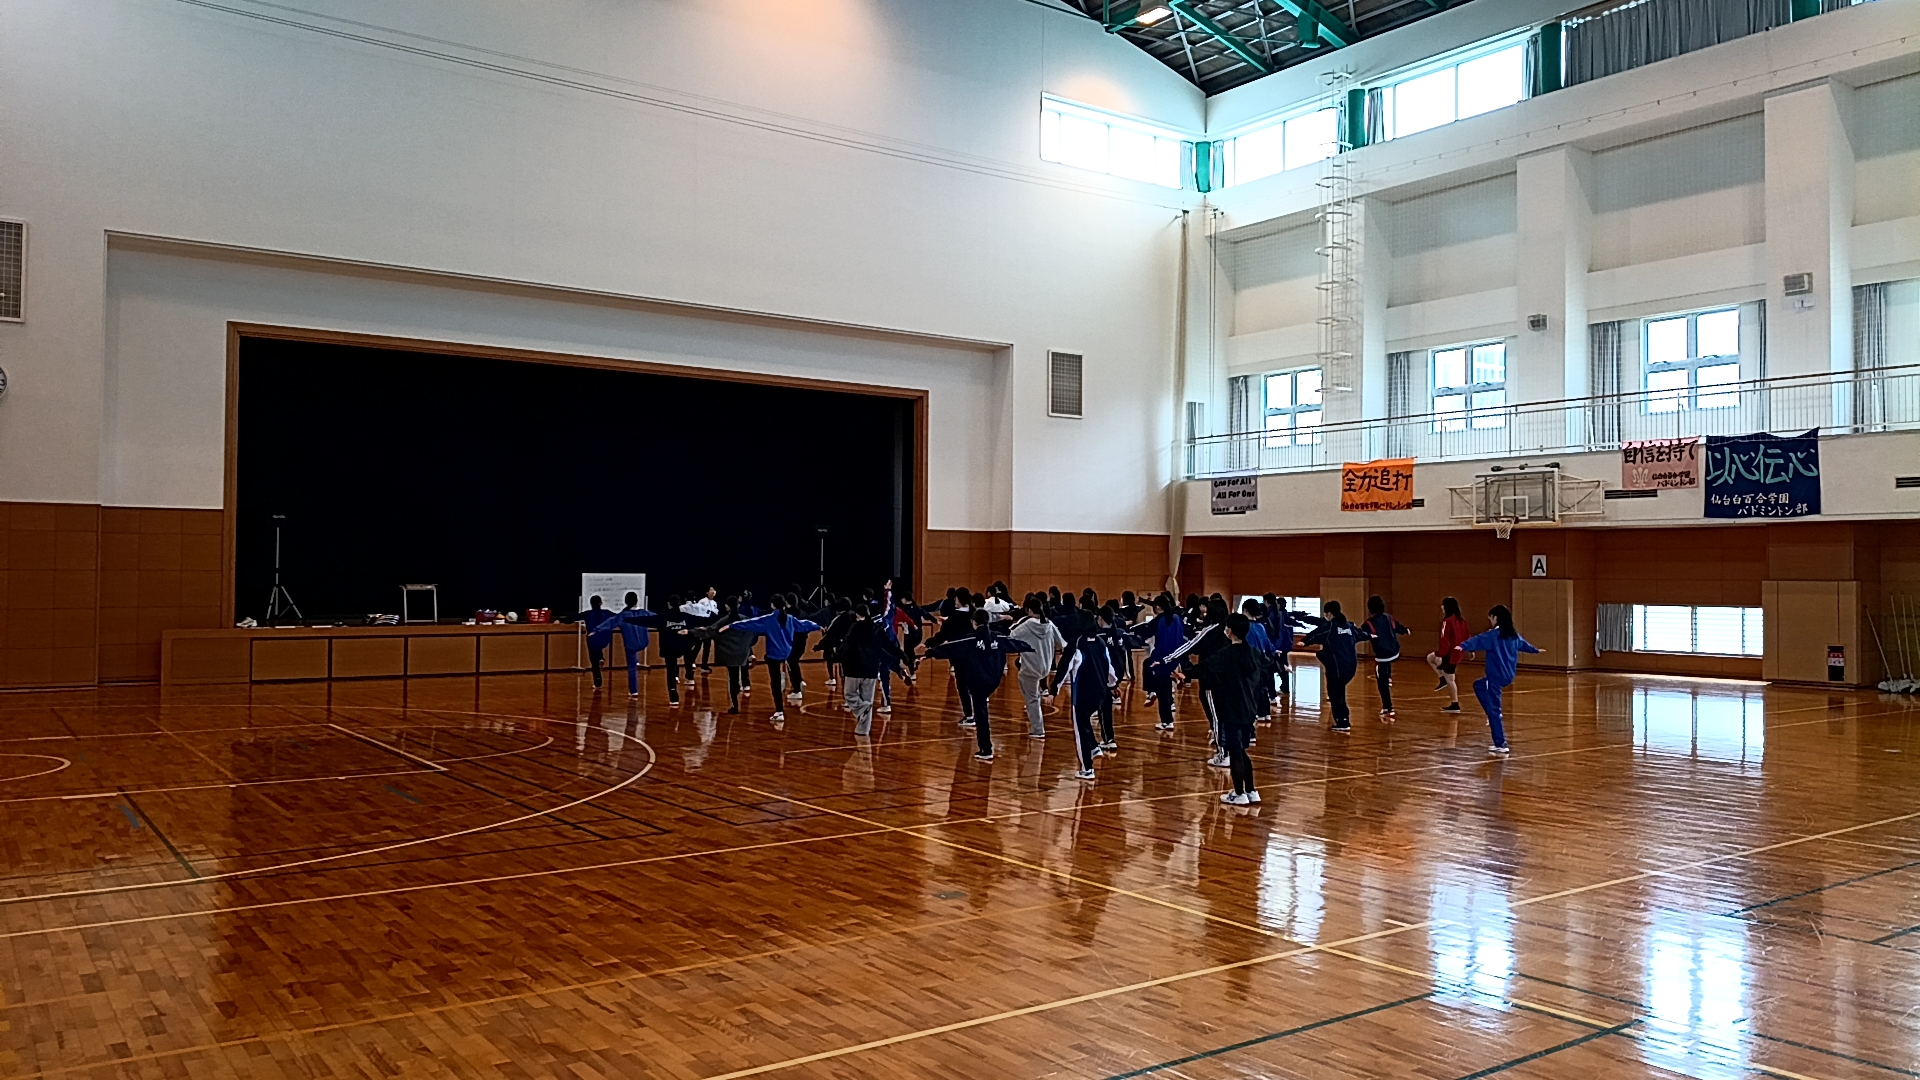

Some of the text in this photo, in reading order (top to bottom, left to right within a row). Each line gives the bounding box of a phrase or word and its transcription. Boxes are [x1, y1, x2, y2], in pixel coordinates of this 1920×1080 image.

[1622, 439, 1698, 464] 自信を持て
[1706, 444, 1818, 486] 以心伝心
[1240, 477, 1251, 485] All
[1343, 467, 1412, 492] 全力追打
[1710, 492, 1789, 506] 仙台白百合学園
[1737, 503, 1809, 516] バドミントン部
[1533, 557, 1546, 573] A
